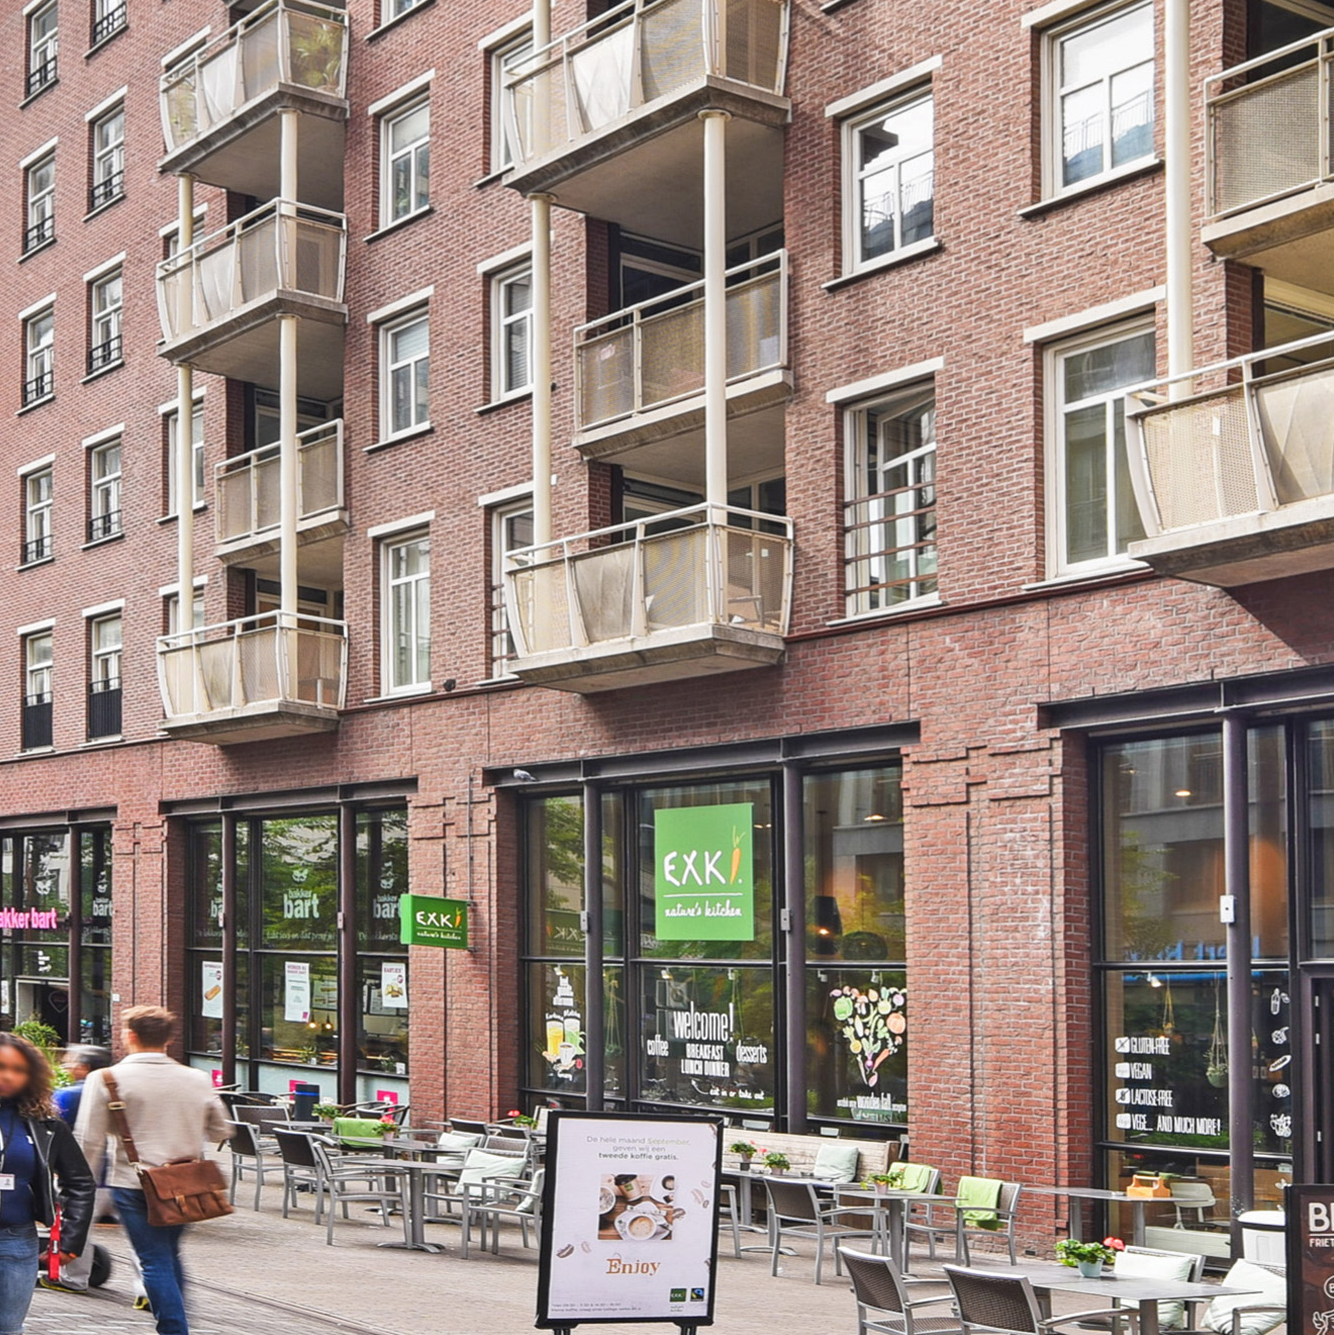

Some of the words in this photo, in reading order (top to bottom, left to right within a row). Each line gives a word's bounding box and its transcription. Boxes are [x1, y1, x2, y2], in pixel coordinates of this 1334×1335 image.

[283, 893, 319, 919] bart
[664, 901, 702, 917] nature's
[704, 899, 742, 917] kitchen
[31, 907, 58, 930] bart
[673, 1000, 734, 1042] welcome!
[647, 1033, 669, 1057] coffee
[685, 1043, 724, 1060] BREAKFAST
[735, 1039, 767, 1064] desserts
[1130, 1036, 1170, 1055] GLUTEN-FREE
[681, 1059, 703, 1076] LUNCH
[704, 1060, 730, 1077] DINNER
[1130, 1063, 1152, 1080] VEGAN
[1130, 1088, 1173, 1107] LACTOSE-FREE
[1157, 1115, 1173, 1133] AND
[1174, 1116, 1195, 1134] MUCH
[618, 1136, 646, 1144] maand
[639, 1145, 650, 1153] wij
[630, 1152, 653, 1160] koffie
[655, 1153, 679, 1161] gratis.
[605, 1258, 661, 1276] Enjoy
